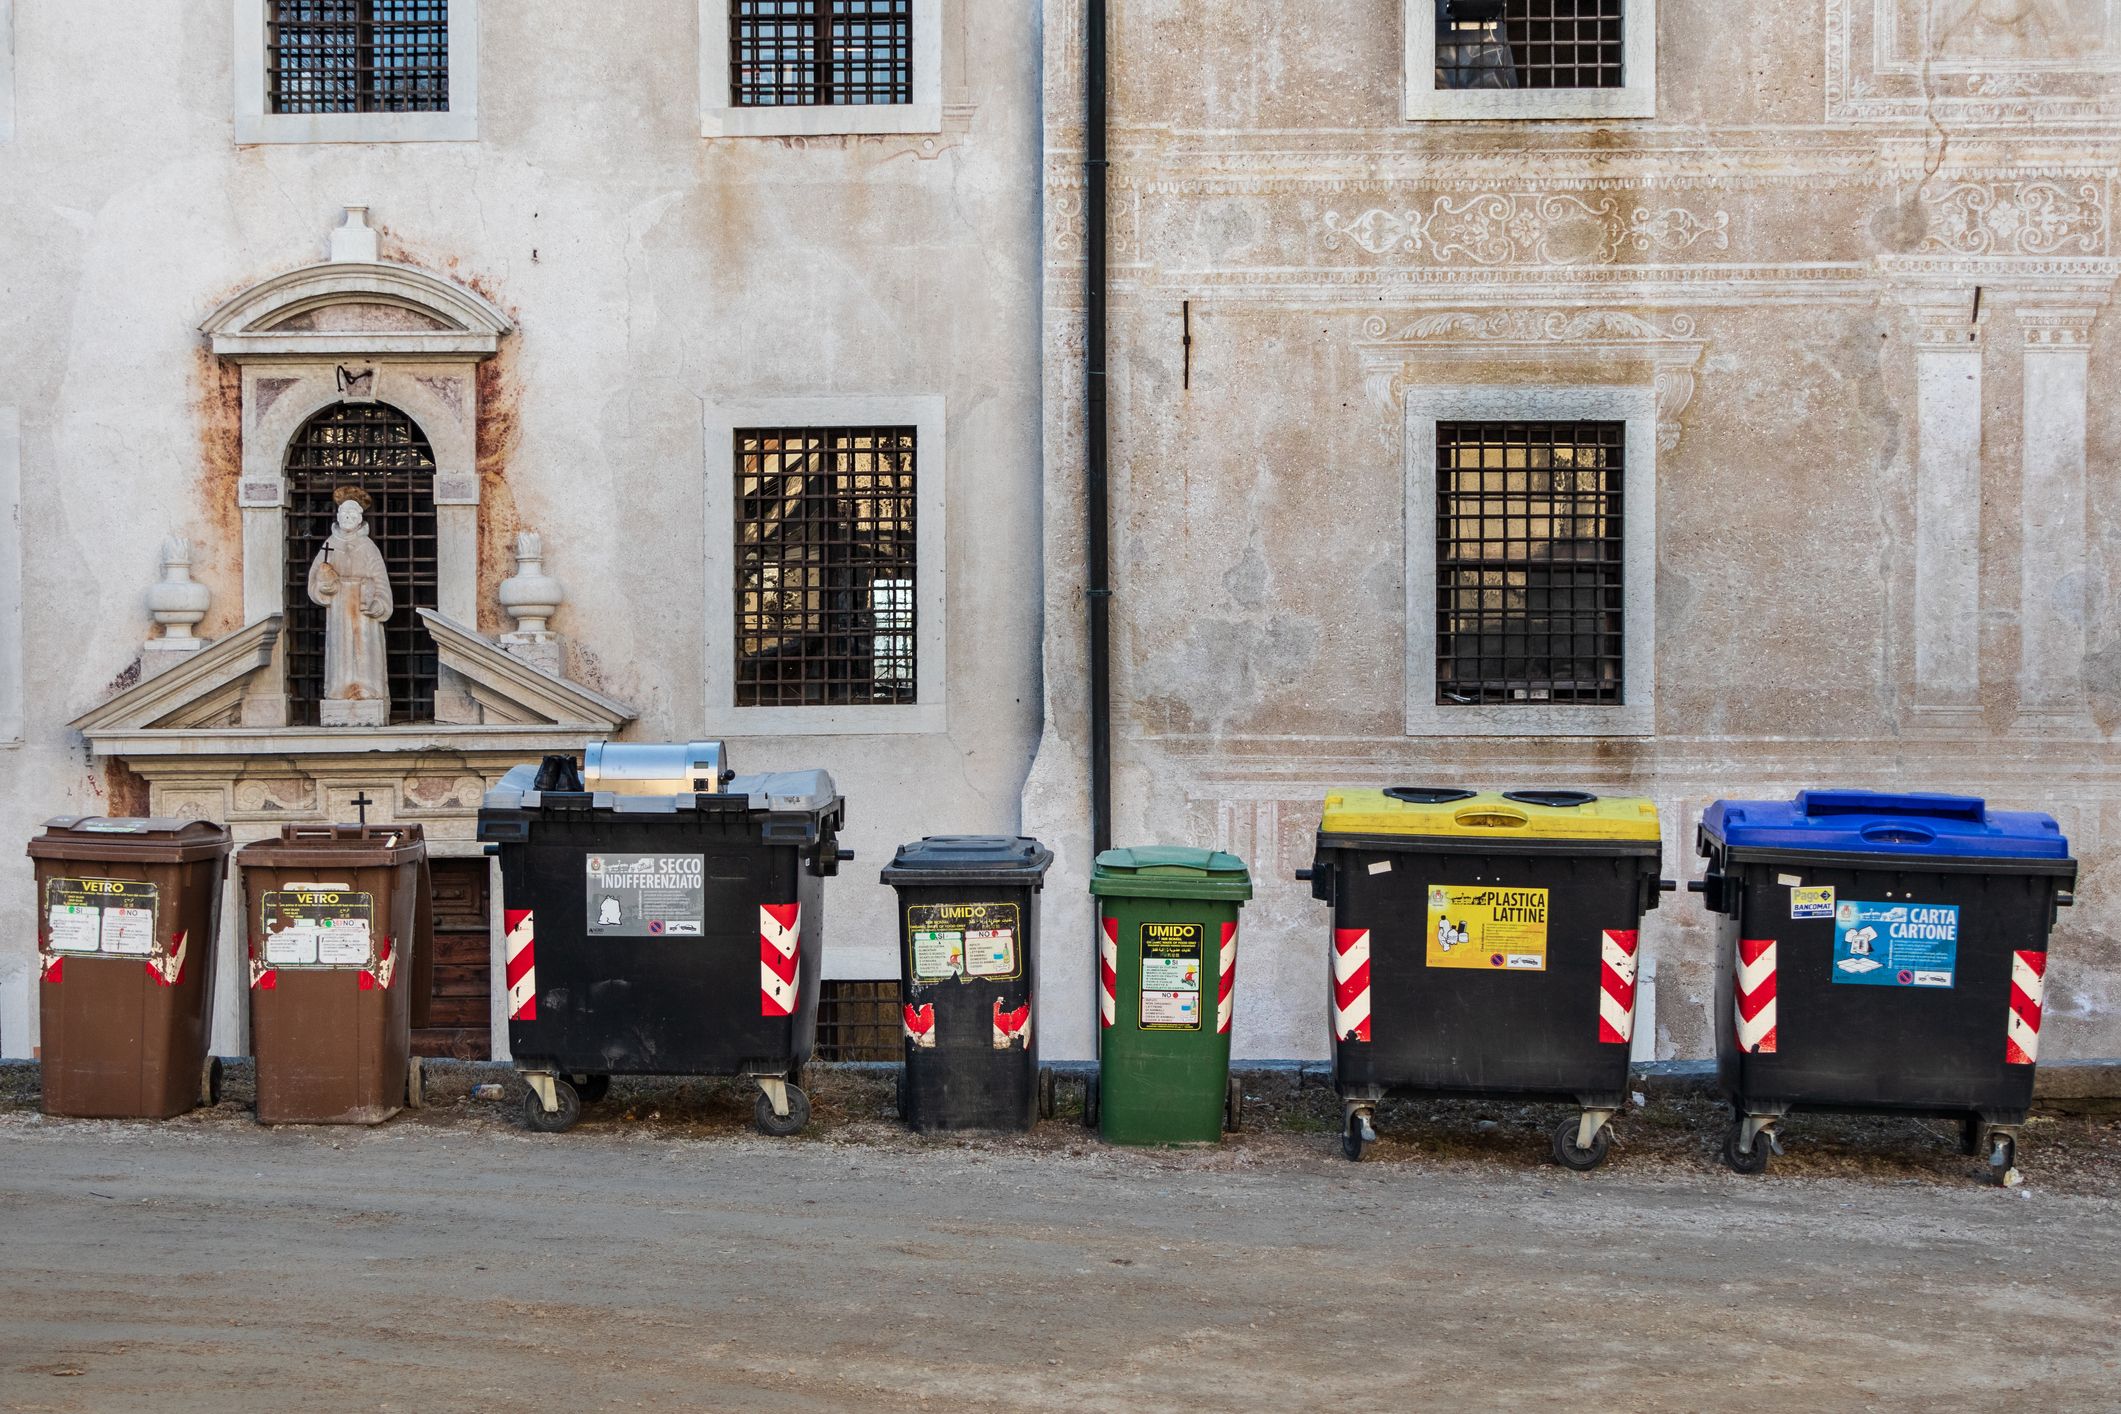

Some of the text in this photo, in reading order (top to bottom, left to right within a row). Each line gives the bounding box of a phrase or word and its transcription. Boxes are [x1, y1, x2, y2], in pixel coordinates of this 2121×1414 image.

[659, 858, 701, 874] SECCO
[82, 880, 124, 893] VETRO
[601, 873, 702, 889] INDIFFERENZIATO
[297, 893, 340, 904] VETRO
[1487, 891, 1546, 908] PLASTICA
[1793, 889, 1820, 903] Pago
[940, 906, 986, 919] UMIDO
[1794, 903, 1832, 911] BANCOMAT
[1493, 906, 1545, 923] LATTINE
[1910, 907, 1957, 925] CARTA
[937, 932, 945, 940] SI
[978, 930, 991, 938] NO
[1149, 925, 1195, 937] UMIDO
[1889, 922, 1956, 941] CARTONE
